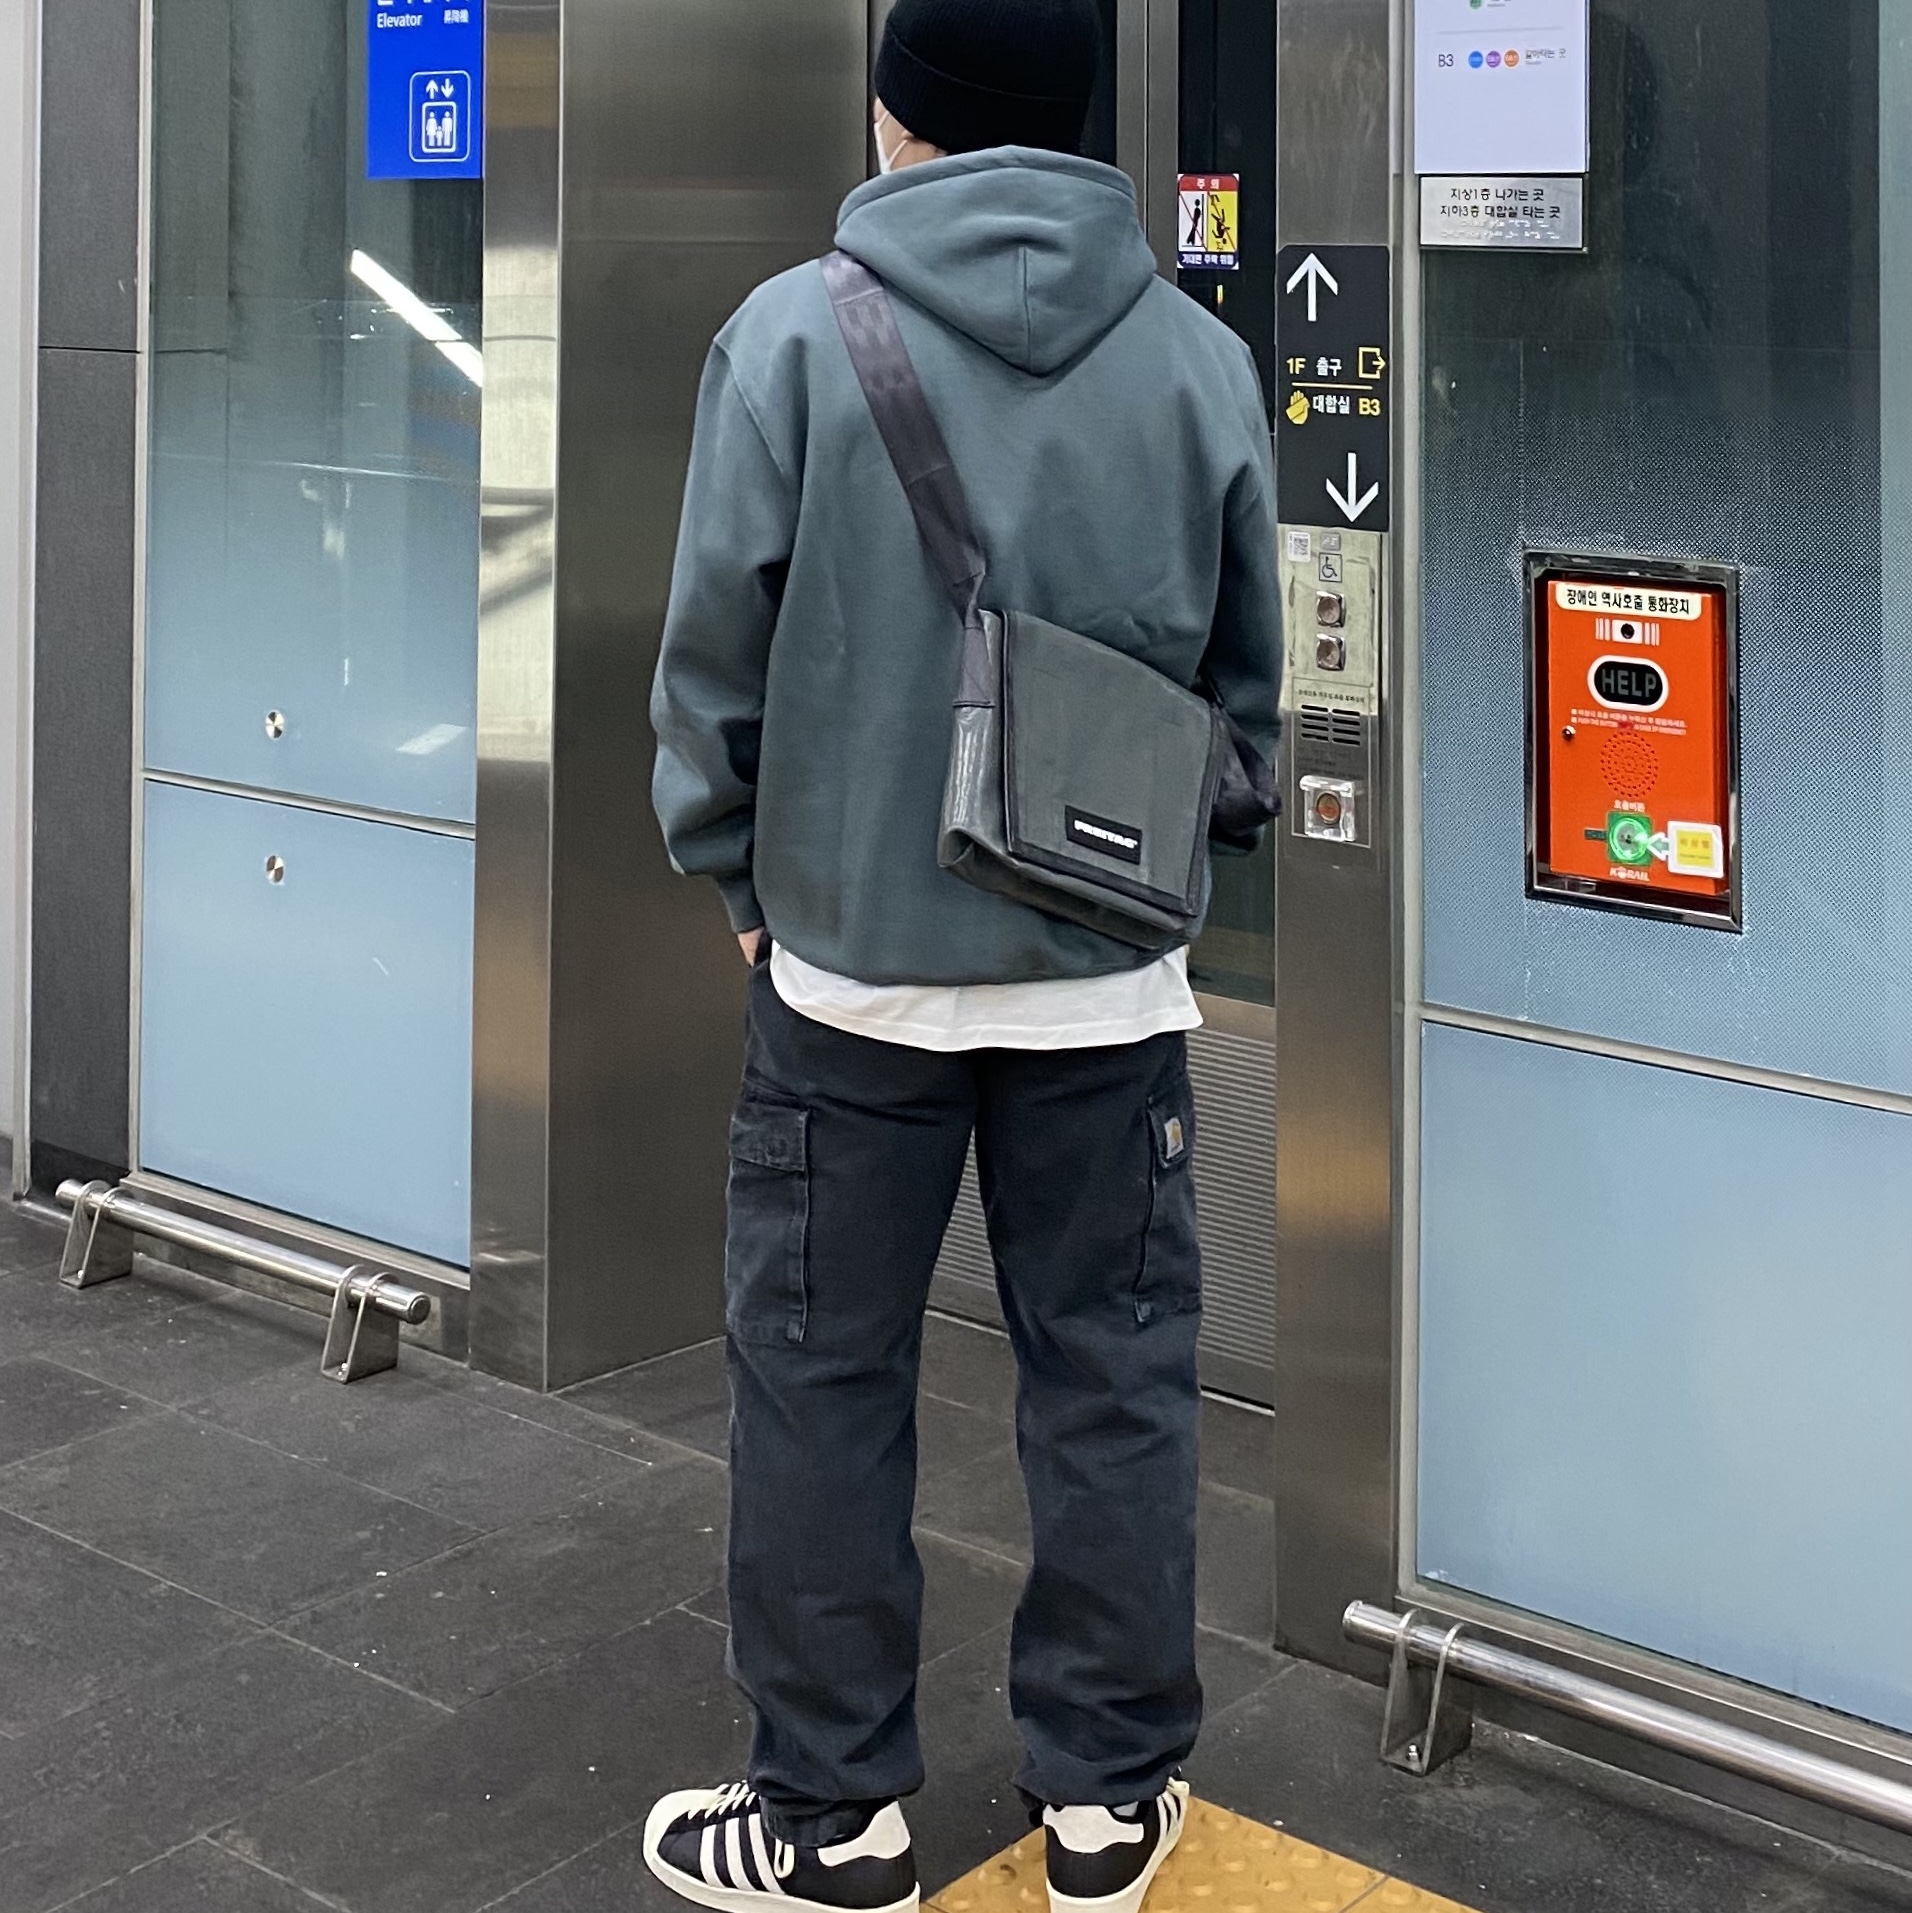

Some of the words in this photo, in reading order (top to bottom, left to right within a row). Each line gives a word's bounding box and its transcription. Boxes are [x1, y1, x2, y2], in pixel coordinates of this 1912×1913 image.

[377, 12, 422, 28] Elevator
[1438, 54, 1454, 68] B3
[1450, 188, 1490, 200] 지상1층
[1495, 188, 1528, 201] 나가는
[1533, 188, 1544, 201] 곳
[1440, 205, 1479, 218] 지하3층
[1484, 205, 1518, 218] 대합실
[1522, 205, 1545, 218] 타는
[1549, 205, 1561, 218] 곳
[1286, 357, 1307, 375] 1F
[1316, 356, 1342, 376] 출구
[1312, 395, 1350, 415] 대합실
[1358, 398, 1381, 416] B3
[1567, 589, 1597, 606] 장애인
[1648, 595, 1690, 615] 통화장치
[1601, 668, 1657, 698] HELP
[1609, 866, 1650, 882] KORAIL
